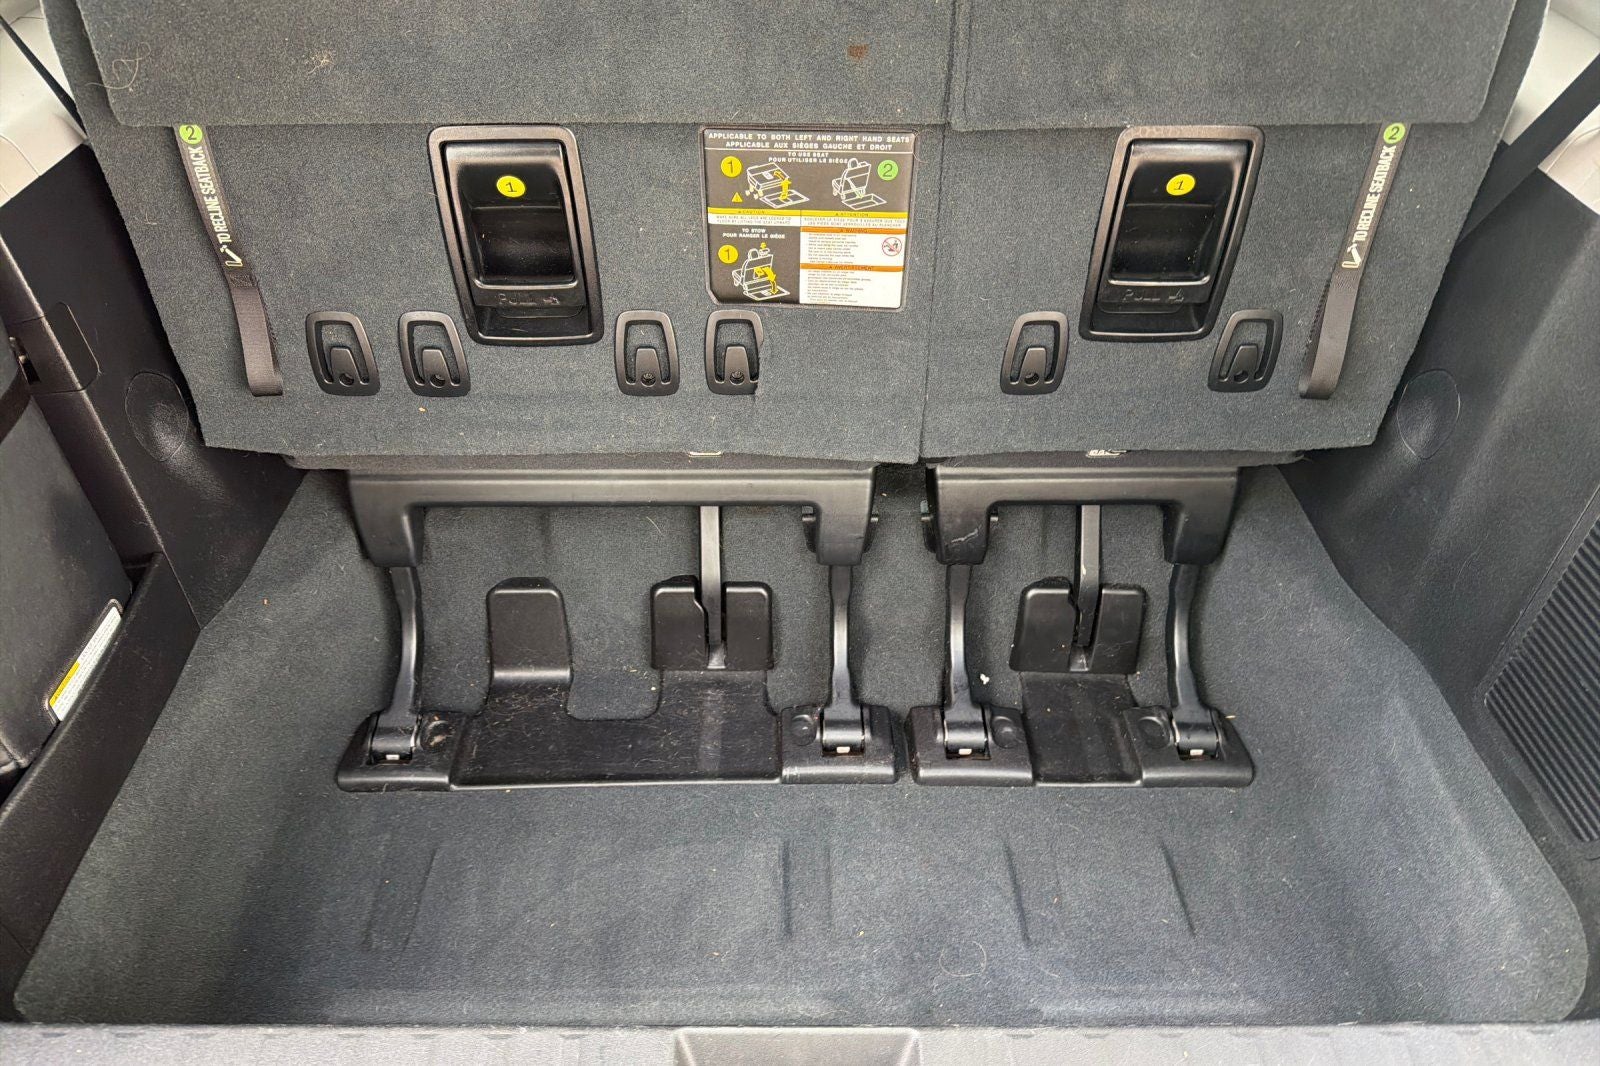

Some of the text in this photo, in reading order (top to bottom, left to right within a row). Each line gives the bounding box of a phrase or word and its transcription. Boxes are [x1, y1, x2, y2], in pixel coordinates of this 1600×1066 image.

[186, 126, 198, 140] 2
[1388, 126, 1400, 140] 2
[883, 164, 892, 177] 2
[188, 146, 232, 244] TO RECLINE SEATBACK
[1352, 145, 1396, 242] TO RECLINE SEATBACK
